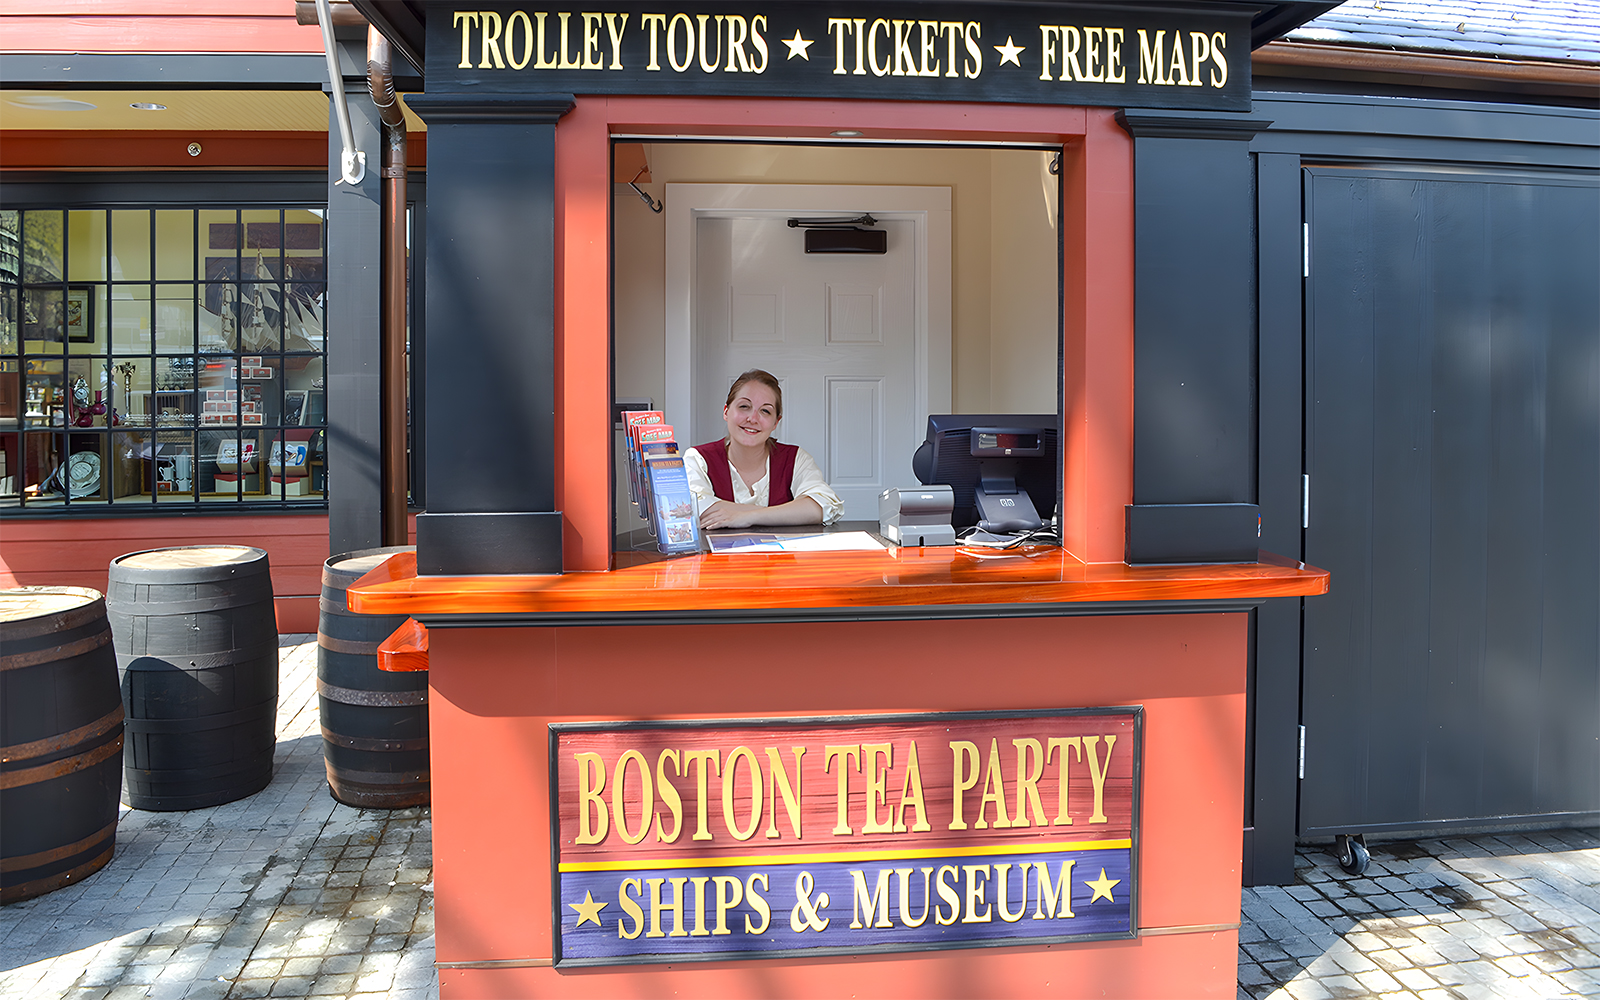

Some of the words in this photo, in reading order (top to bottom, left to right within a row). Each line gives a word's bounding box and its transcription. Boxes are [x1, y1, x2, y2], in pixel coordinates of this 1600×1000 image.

[453, 10, 629, 71] TROLLEY
[641, 13, 769, 74] TOURS
[827, 18, 983, 80] TICKETS
[1038, 24, 1126, 84] FREE
[1136, 28, 1229, 89] MAPS
[574, 746, 806, 846] BOSTON
[825, 740, 932, 837] TEA
[948, 734, 1117, 831] PARTY
[617, 872, 771, 940] SHIPS
[789, 870, 831, 933] &
[849, 860, 1077, 931] MUSEUM
